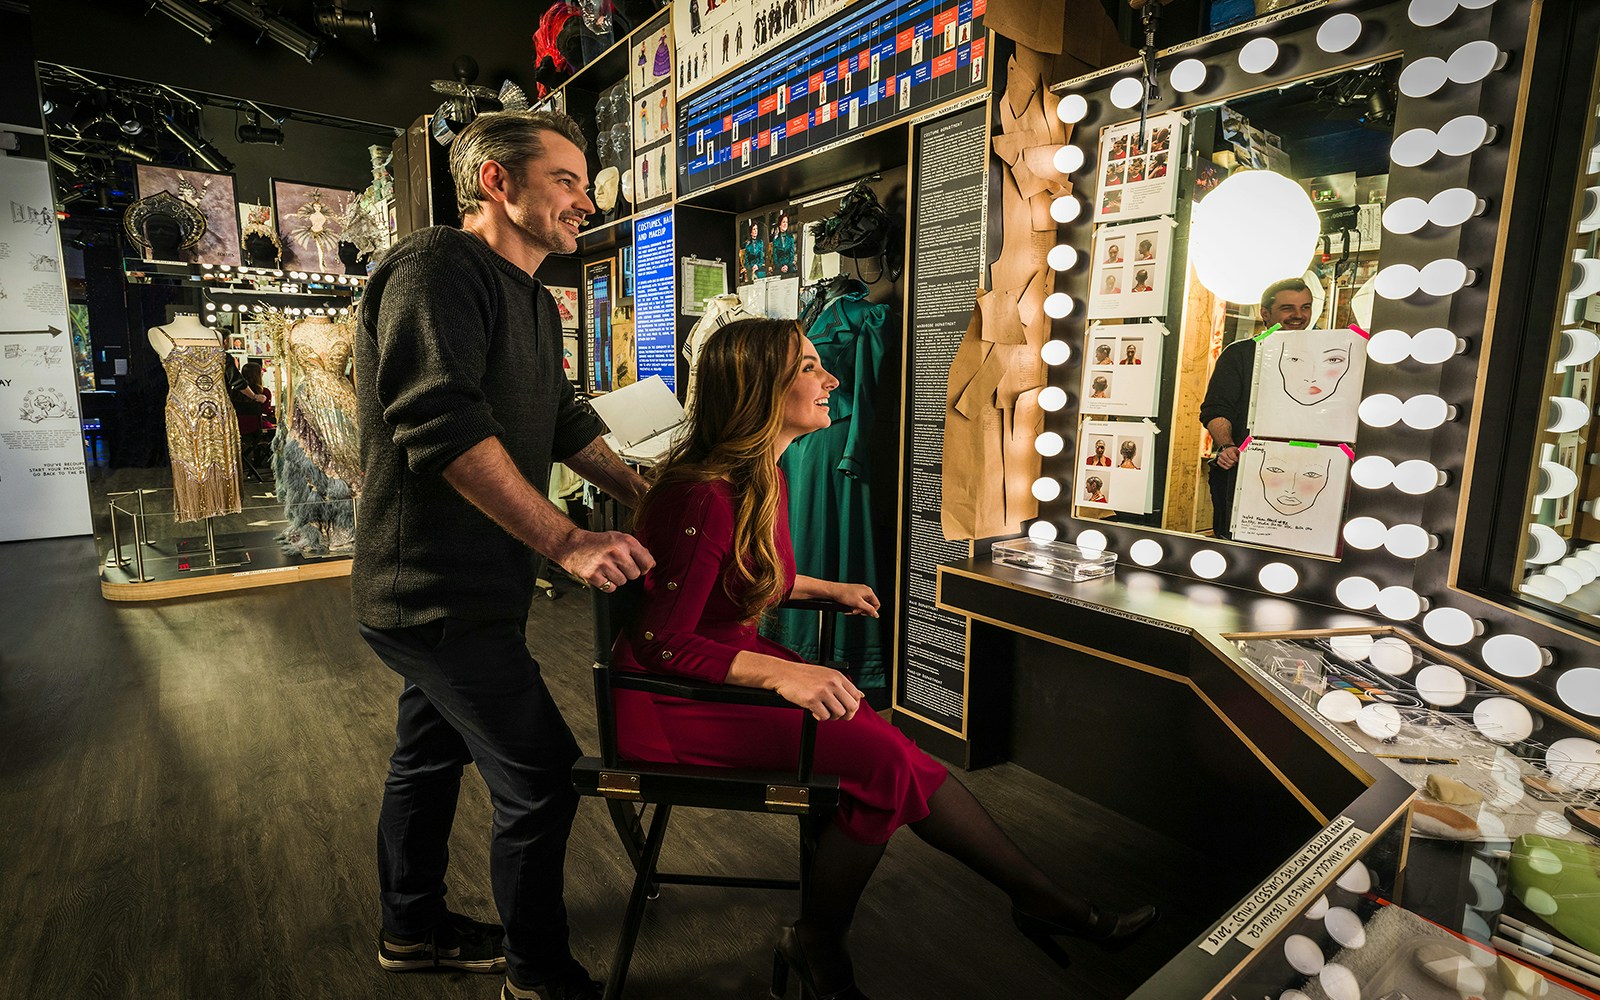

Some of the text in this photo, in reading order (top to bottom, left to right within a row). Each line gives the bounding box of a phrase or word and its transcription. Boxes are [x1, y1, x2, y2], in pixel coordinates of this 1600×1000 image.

[638, 219, 662, 232] COSTUMES,
[638, 227, 666, 241] AND MAKEUP
[1306, 834, 1332, 855] POTTER
[1294, 854, 1311, 867] AND
[1280, 866, 1297, 879] THE
[1254, 876, 1284, 904] CURSED
[1247, 903, 1288, 938] DESIGNER
